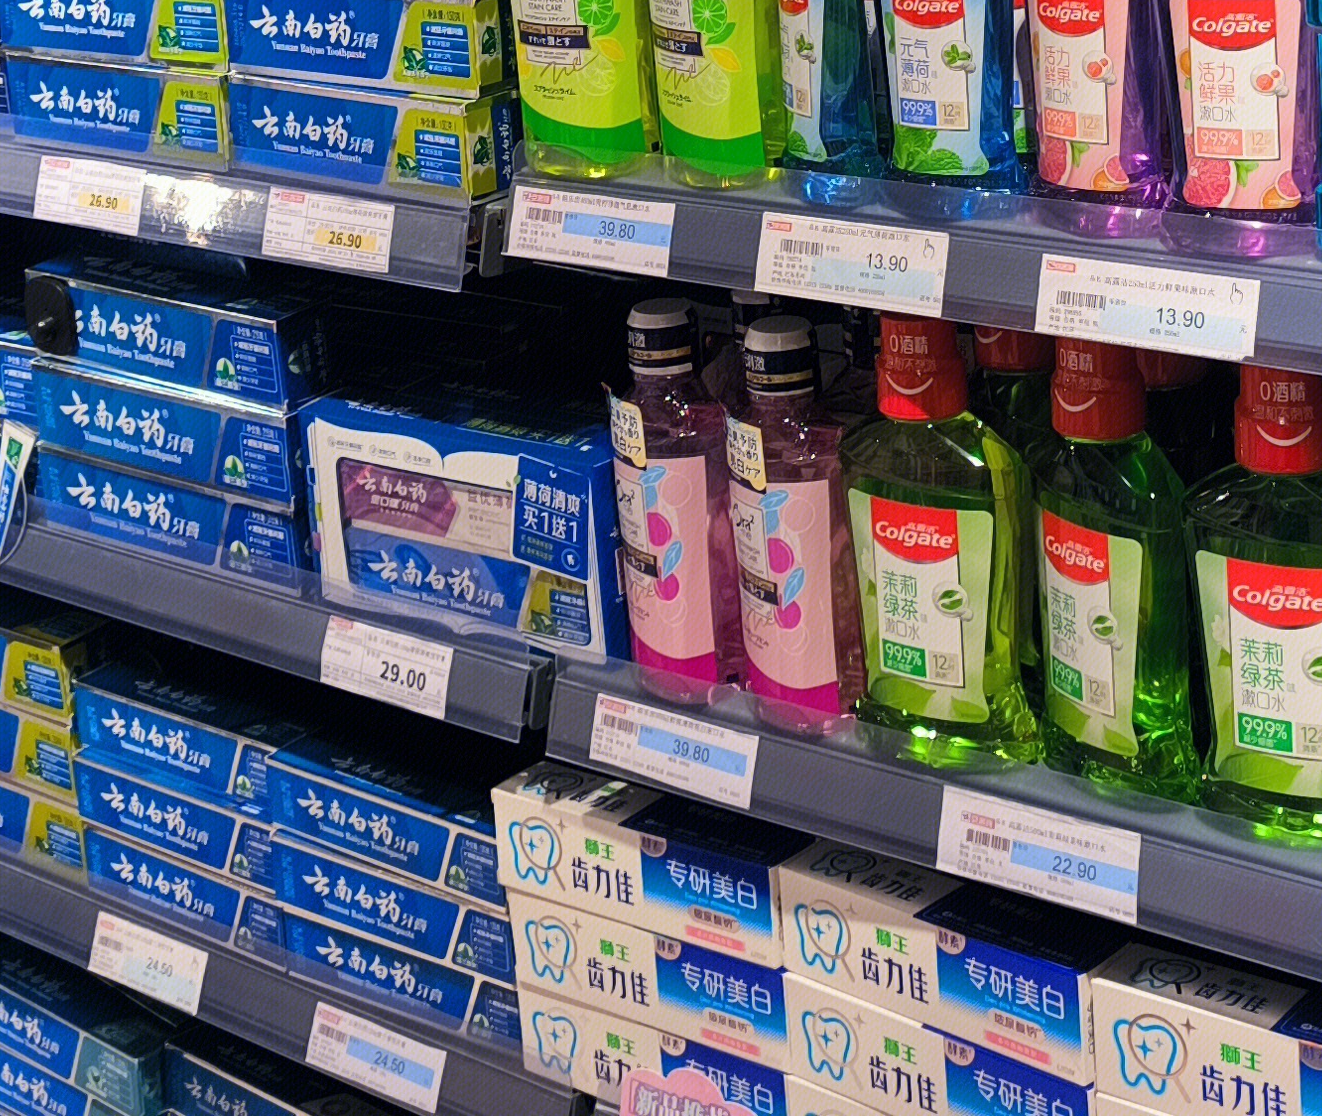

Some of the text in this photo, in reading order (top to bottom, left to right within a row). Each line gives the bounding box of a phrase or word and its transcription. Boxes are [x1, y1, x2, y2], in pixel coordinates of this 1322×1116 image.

[1039, 2, 1100, 23] Colgate
[1192, 16, 1272, 35] Colgate
[900, 38, 930, 59] 元气
[900, 57, 930, 78] 薄荷
[1198, 62, 1235, 83] 活力
[1198, 83, 1236, 104] 鲜果
[902, 101, 934, 117] 99.9%
[1198, 104, 1238, 123] 漱口水
[1200, 129, 1239, 146] 99.9%
[88, 194, 119, 211] 26.90
[328, 231, 363, 249] 26.90
[597, 220, 636, 241] 39.80
[865, 252, 909, 273] 13.90
[1155, 306, 1206, 329] 13.90
[523, 478, 580, 518] 薄荷清爽
[876, 521, 954, 549] Colgate
[882, 570, 917, 599] 茉莉
[883, 594, 918, 623] 绿茶
[885, 644, 923, 667] 99.9%
[1239, 638, 1283, 666] 茉莉
[380, 660, 427, 692] 29.00
[1240, 666, 1286, 691] 绿茶
[1241, 689, 1287, 713] 漱口水
[1241, 716, 1288, 740] 99.9%
[672, 737, 711, 764] 39.80
[1052, 854, 1098, 883] 22.90
[570, 862, 635, 907] 齿力佳
[666, 859, 759, 911] 专研美白
[145, 955, 173, 978] 24.50
[860, 955, 930, 1007] 齿力佳
[963, 957, 1065, 1020] 专研美白
[373, 1050, 406, 1076] 24.50
